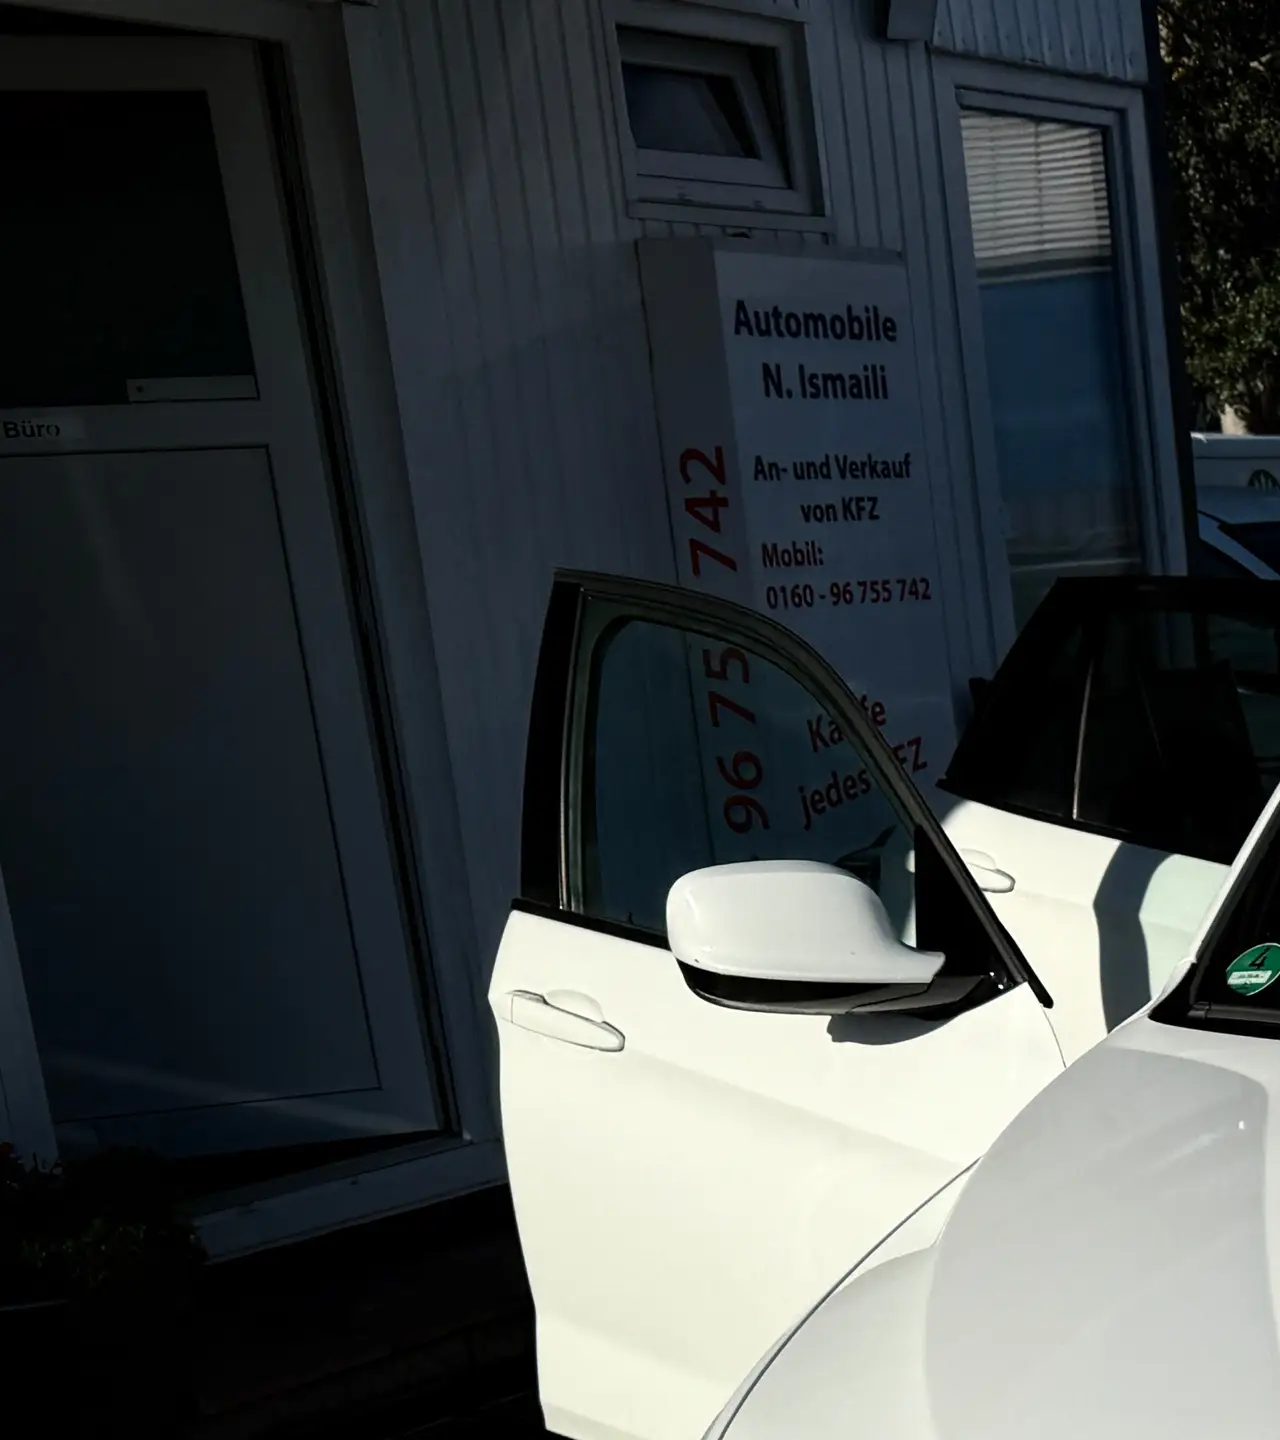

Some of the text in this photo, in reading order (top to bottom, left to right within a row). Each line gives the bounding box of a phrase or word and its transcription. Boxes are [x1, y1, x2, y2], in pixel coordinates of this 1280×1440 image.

[734, 300, 897, 341] Automobile
[762, 362, 889, 400] N. Ismaili
[3, 420, 60, 438] Büro
[754, 453, 911, 481] An- und Verkauf
[801, 497, 880, 522] von KFZ
[762, 540, 824, 567] Mobil:
[766, 584, 814, 609] 0160
[830, 582, 854, 606] 96
[857, 580, 892, 603] 755
[896, 578, 932, 602] 742
[680, 446, 771, 834] 96 75 742
[799, 736, 927, 830] jedes FZ
